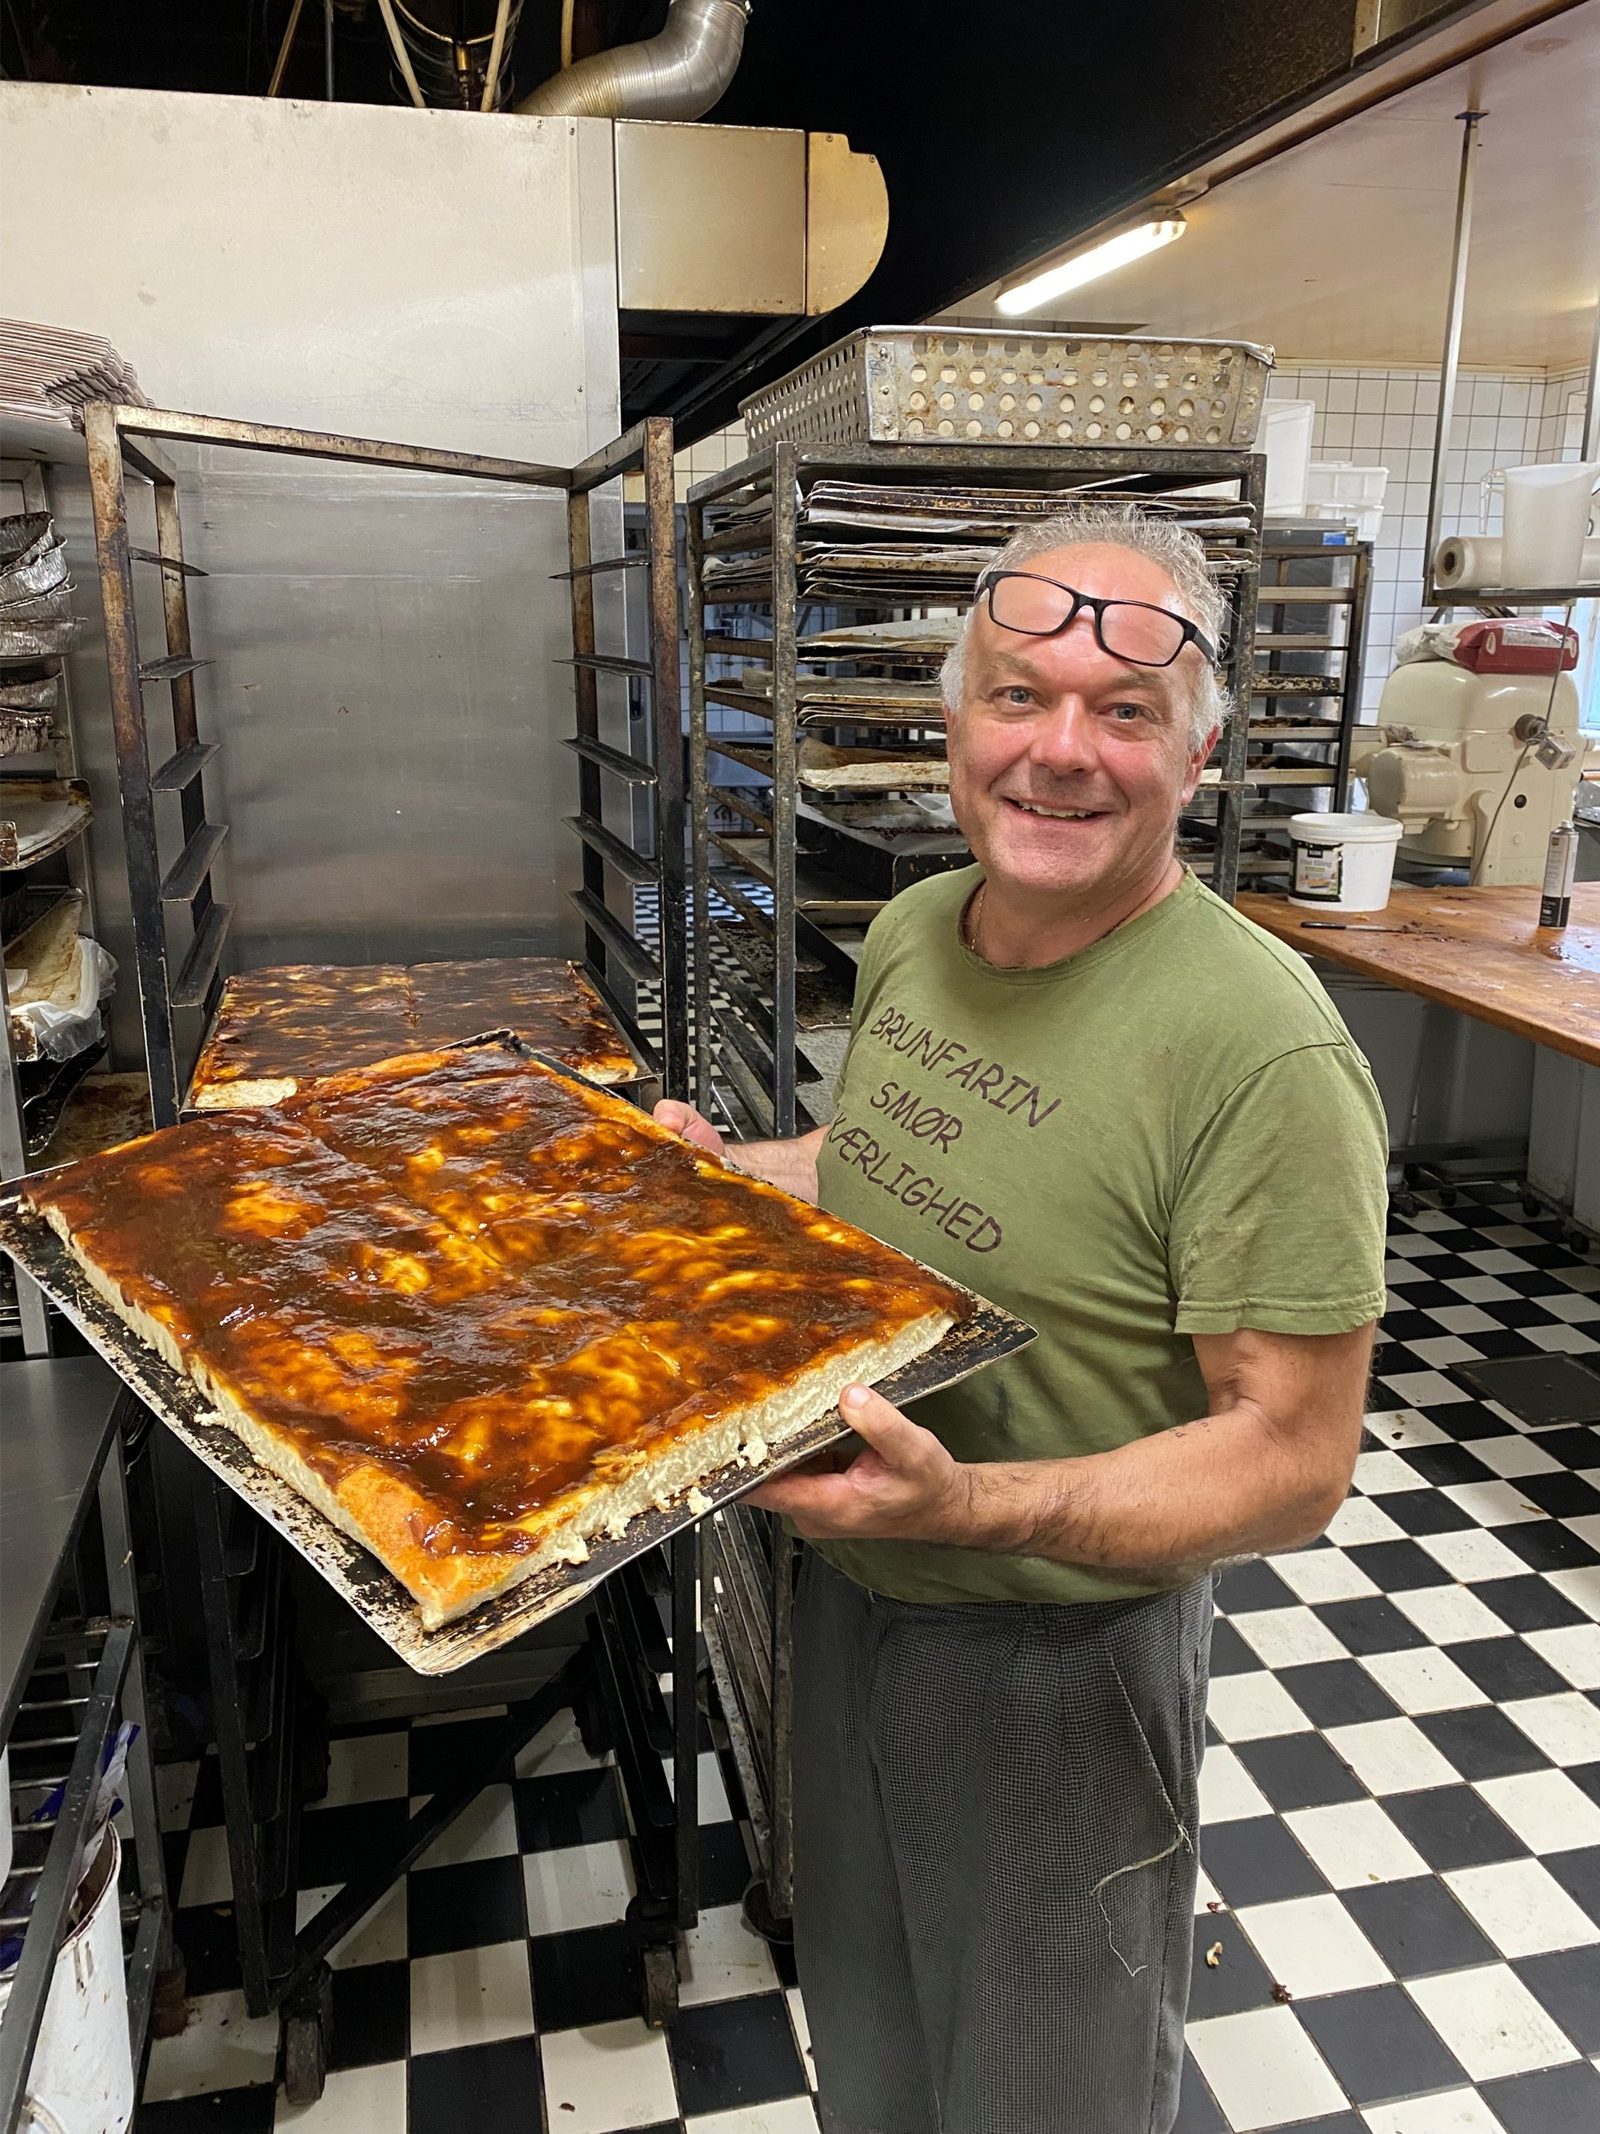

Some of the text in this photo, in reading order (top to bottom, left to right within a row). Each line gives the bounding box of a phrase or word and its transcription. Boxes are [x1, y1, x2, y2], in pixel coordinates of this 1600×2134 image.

[870, 1006, 1062, 1128] BRUNFARIN
[870, 1081, 963, 1154] SMØR
[826, 1111, 1002, 1253] KÆRLIGHED
